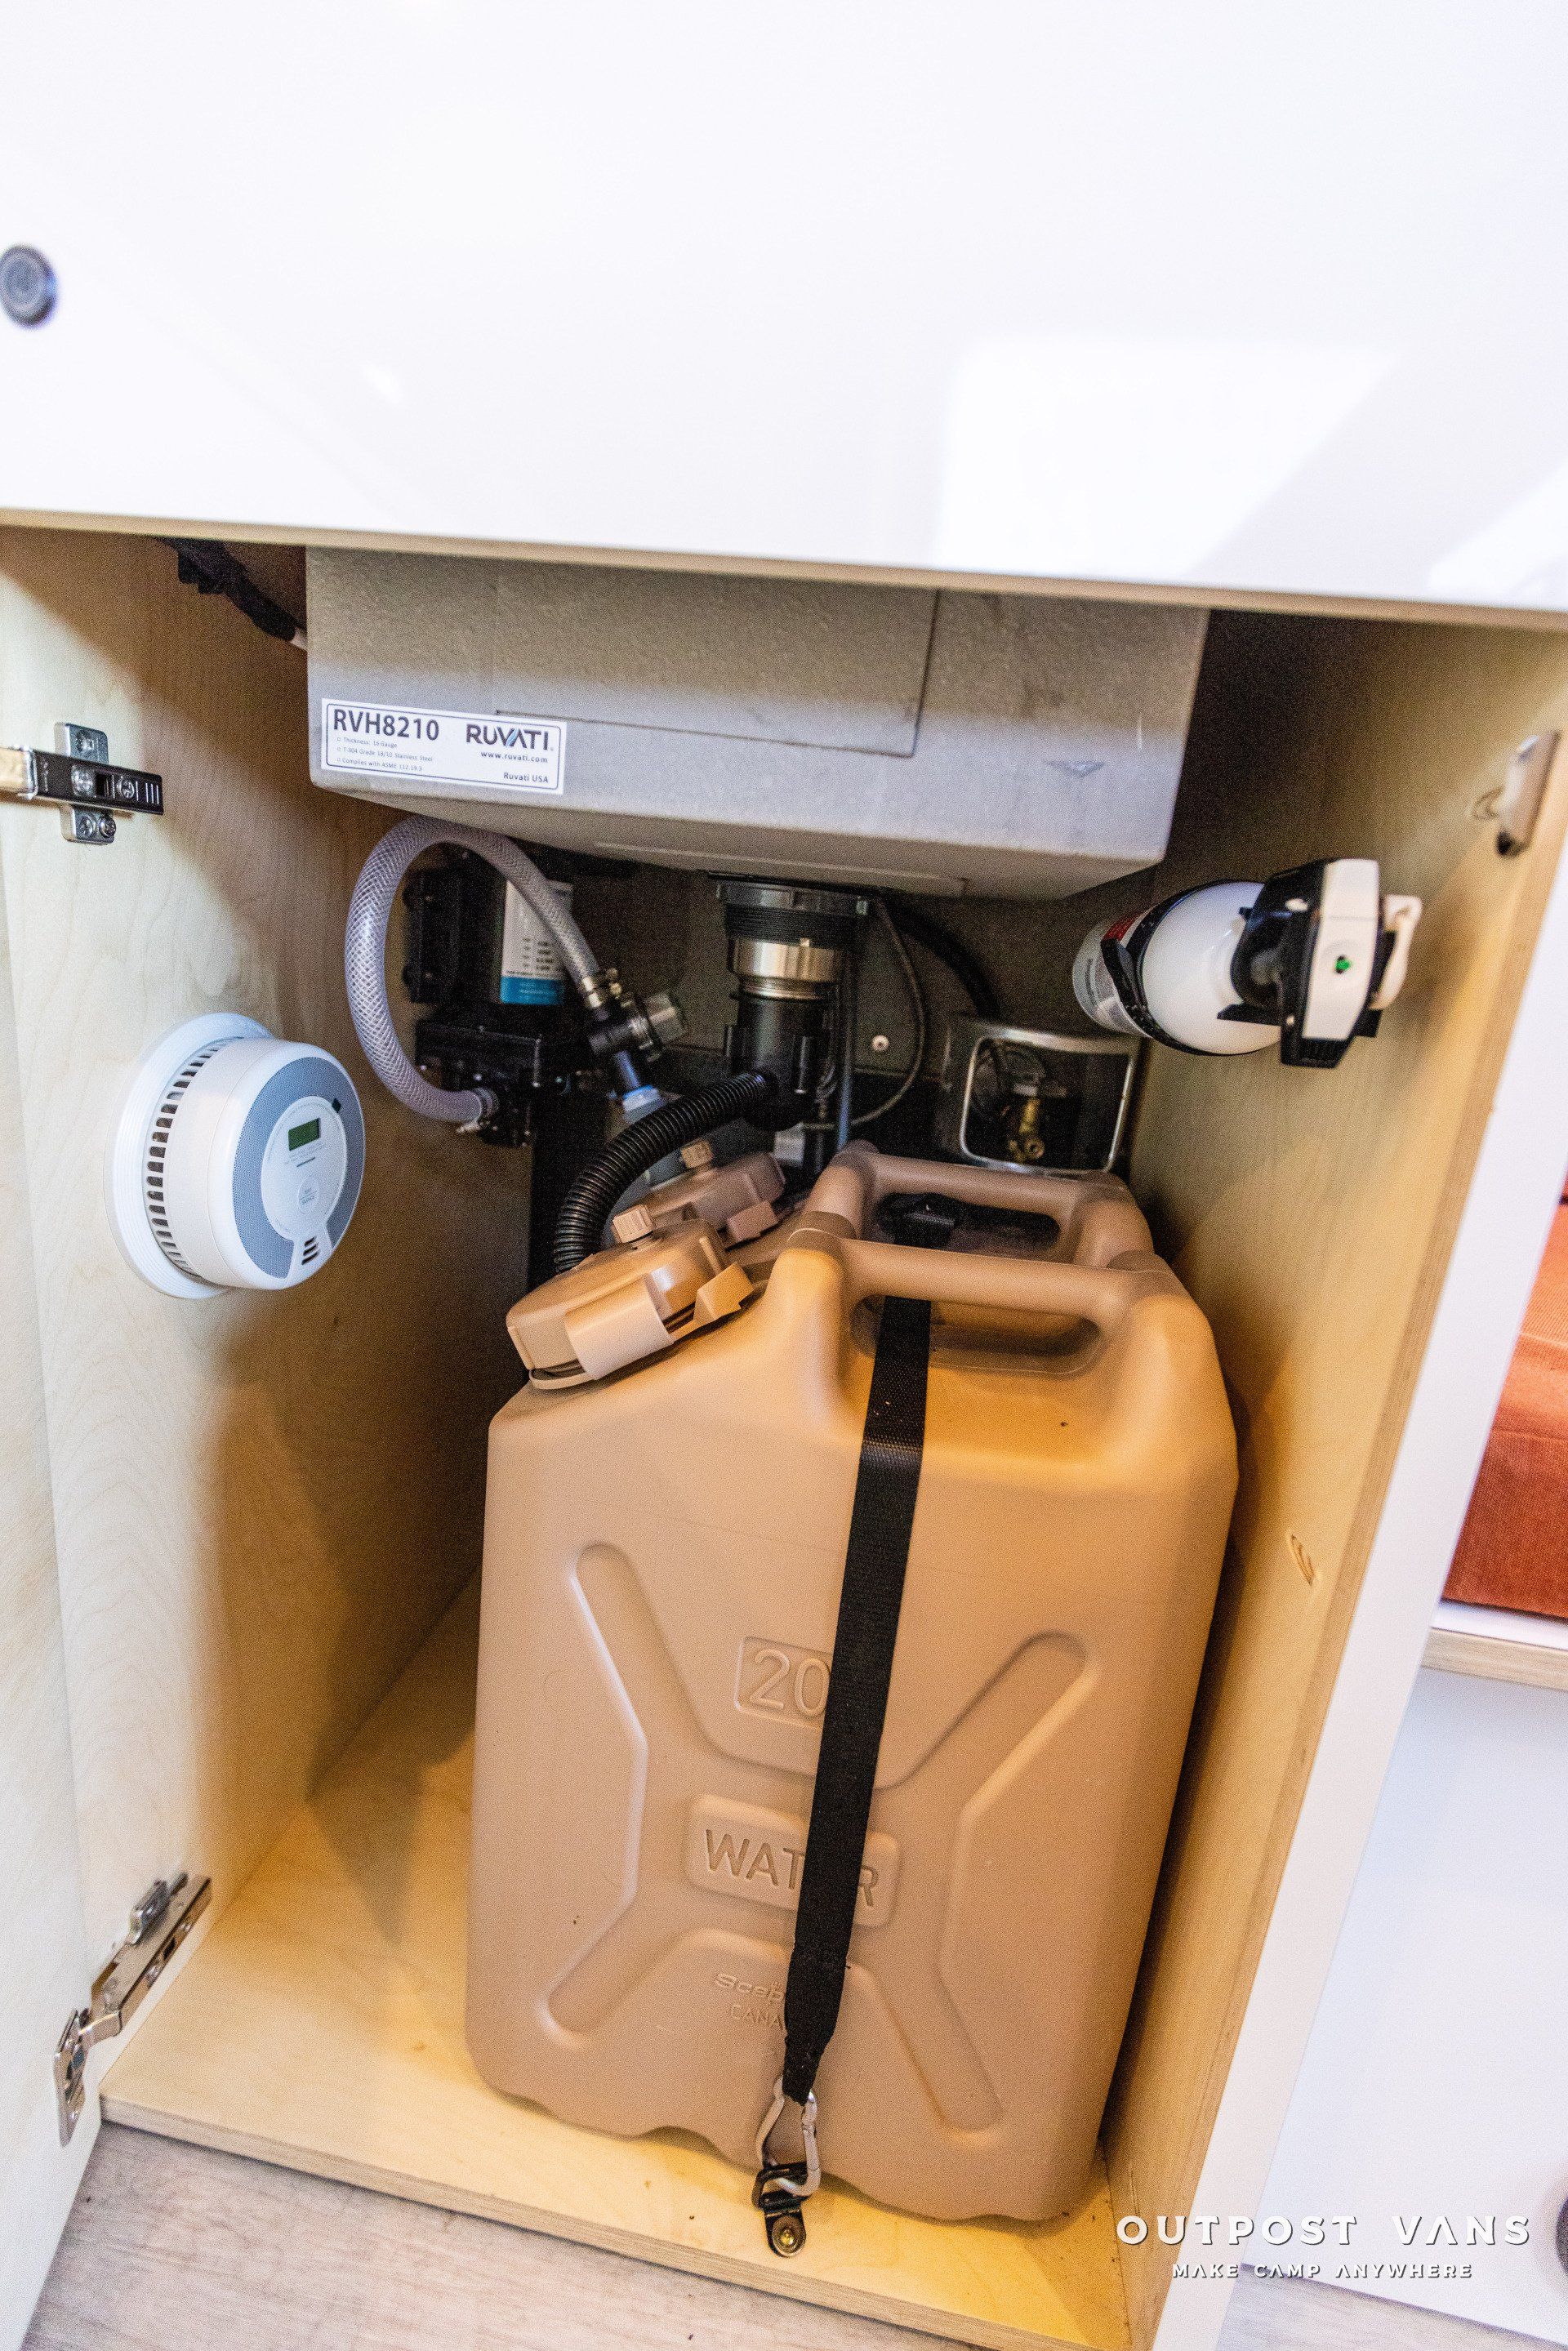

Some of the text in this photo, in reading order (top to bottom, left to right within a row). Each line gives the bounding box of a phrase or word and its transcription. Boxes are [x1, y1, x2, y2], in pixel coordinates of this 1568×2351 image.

[333, 708, 439, 741] RVH8210
[343, 737, 370, 746] Thickness:
[466, 724, 550, 750] RUVATI
[342, 758, 367, 766] Complies
[359, 748, 375, 756] Grade
[394, 752, 417, 761] Stainless
[480, 751, 548, 764] www.ruvati.com
[503, 772, 549, 783] Ruvati USA
[705, 1828, 880, 1908] WATR
[715, 1973, 784, 2004] Scep
[731, 2003, 784, 2030] CANA
